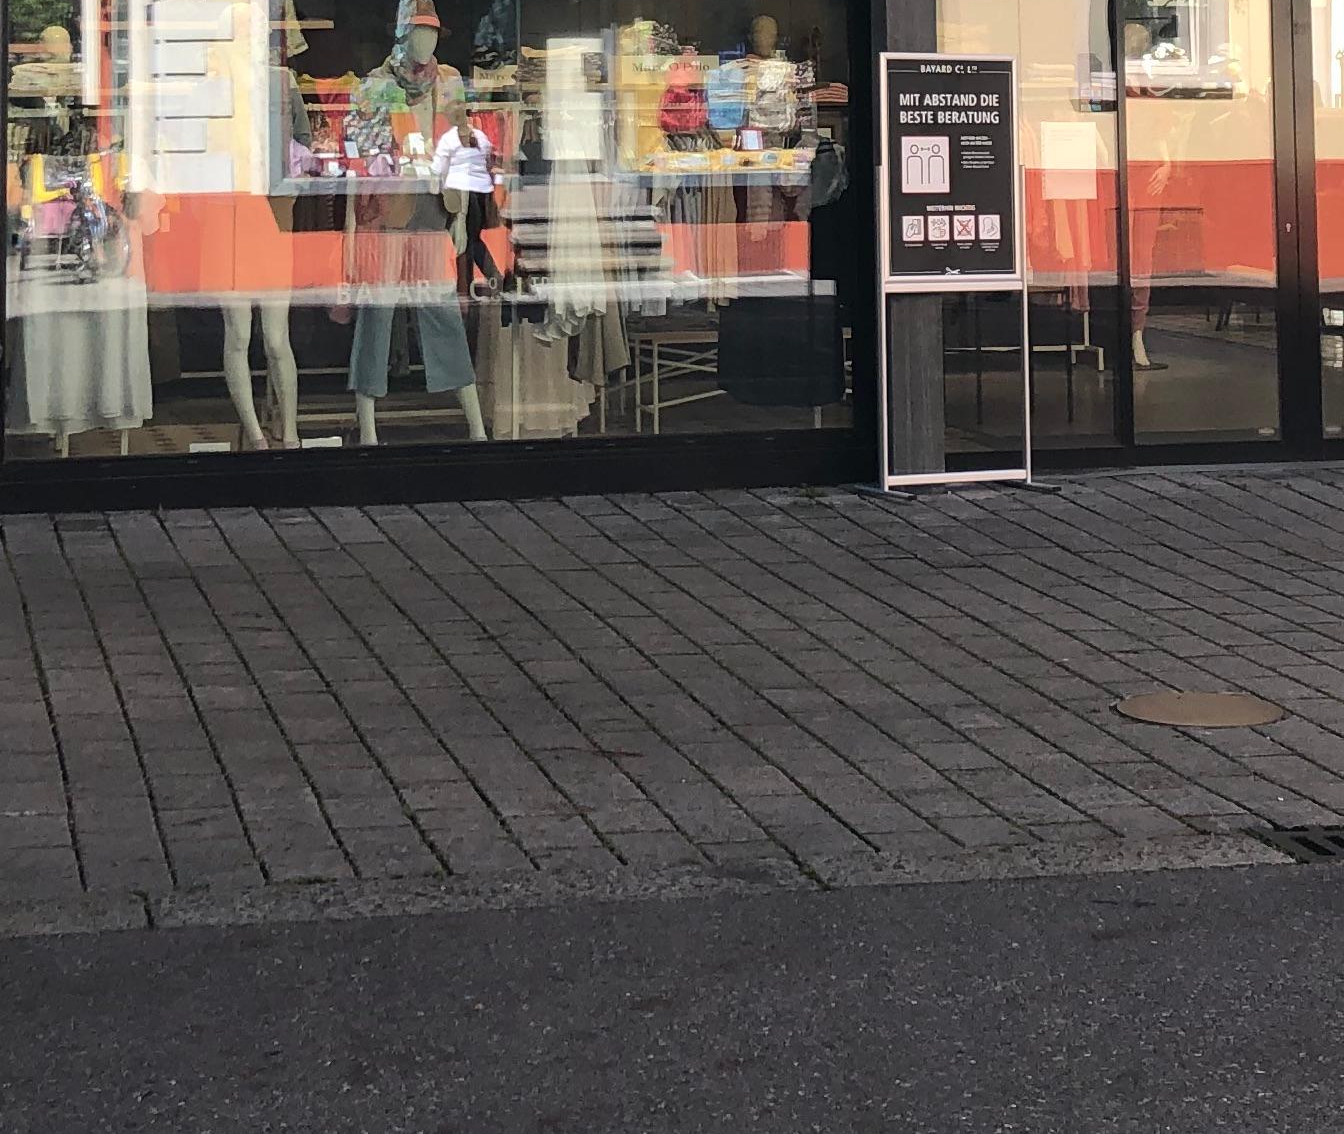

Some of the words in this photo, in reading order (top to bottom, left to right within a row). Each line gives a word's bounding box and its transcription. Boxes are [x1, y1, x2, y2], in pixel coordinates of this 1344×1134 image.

[919, 65, 953, 74] BAYARD
[899, 93, 920, 106] MIT
[923, 93, 977, 107] ABSTAND
[980, 94, 1000, 107] DIE
[899, 111, 934, 124] BESTE
[937, 111, 1000, 124] BERATUNG
